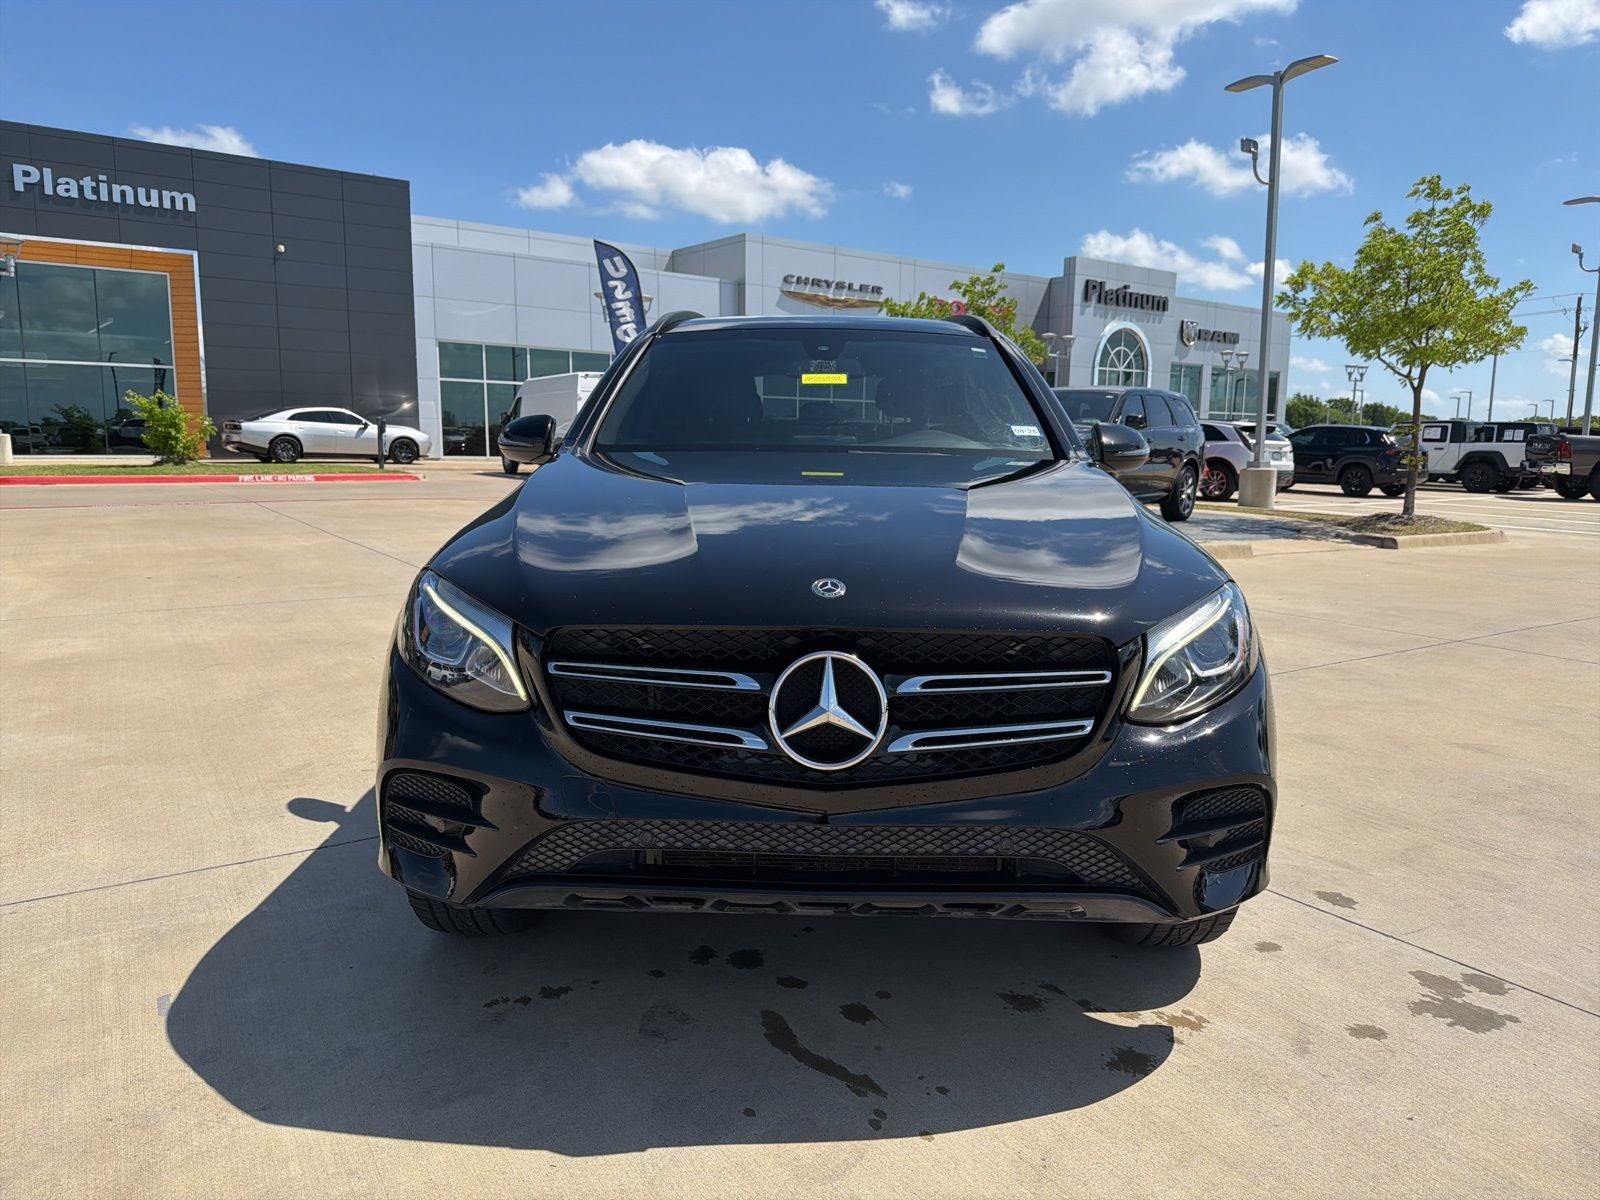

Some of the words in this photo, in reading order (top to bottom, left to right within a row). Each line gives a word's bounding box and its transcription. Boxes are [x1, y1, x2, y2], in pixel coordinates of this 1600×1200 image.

[12, 163, 197, 212] Platinum
[783, 274, 884, 295] CHRYSLER
[1083, 279, 1169, 312] Platinum
[1198, 328, 1240, 344] RAM
